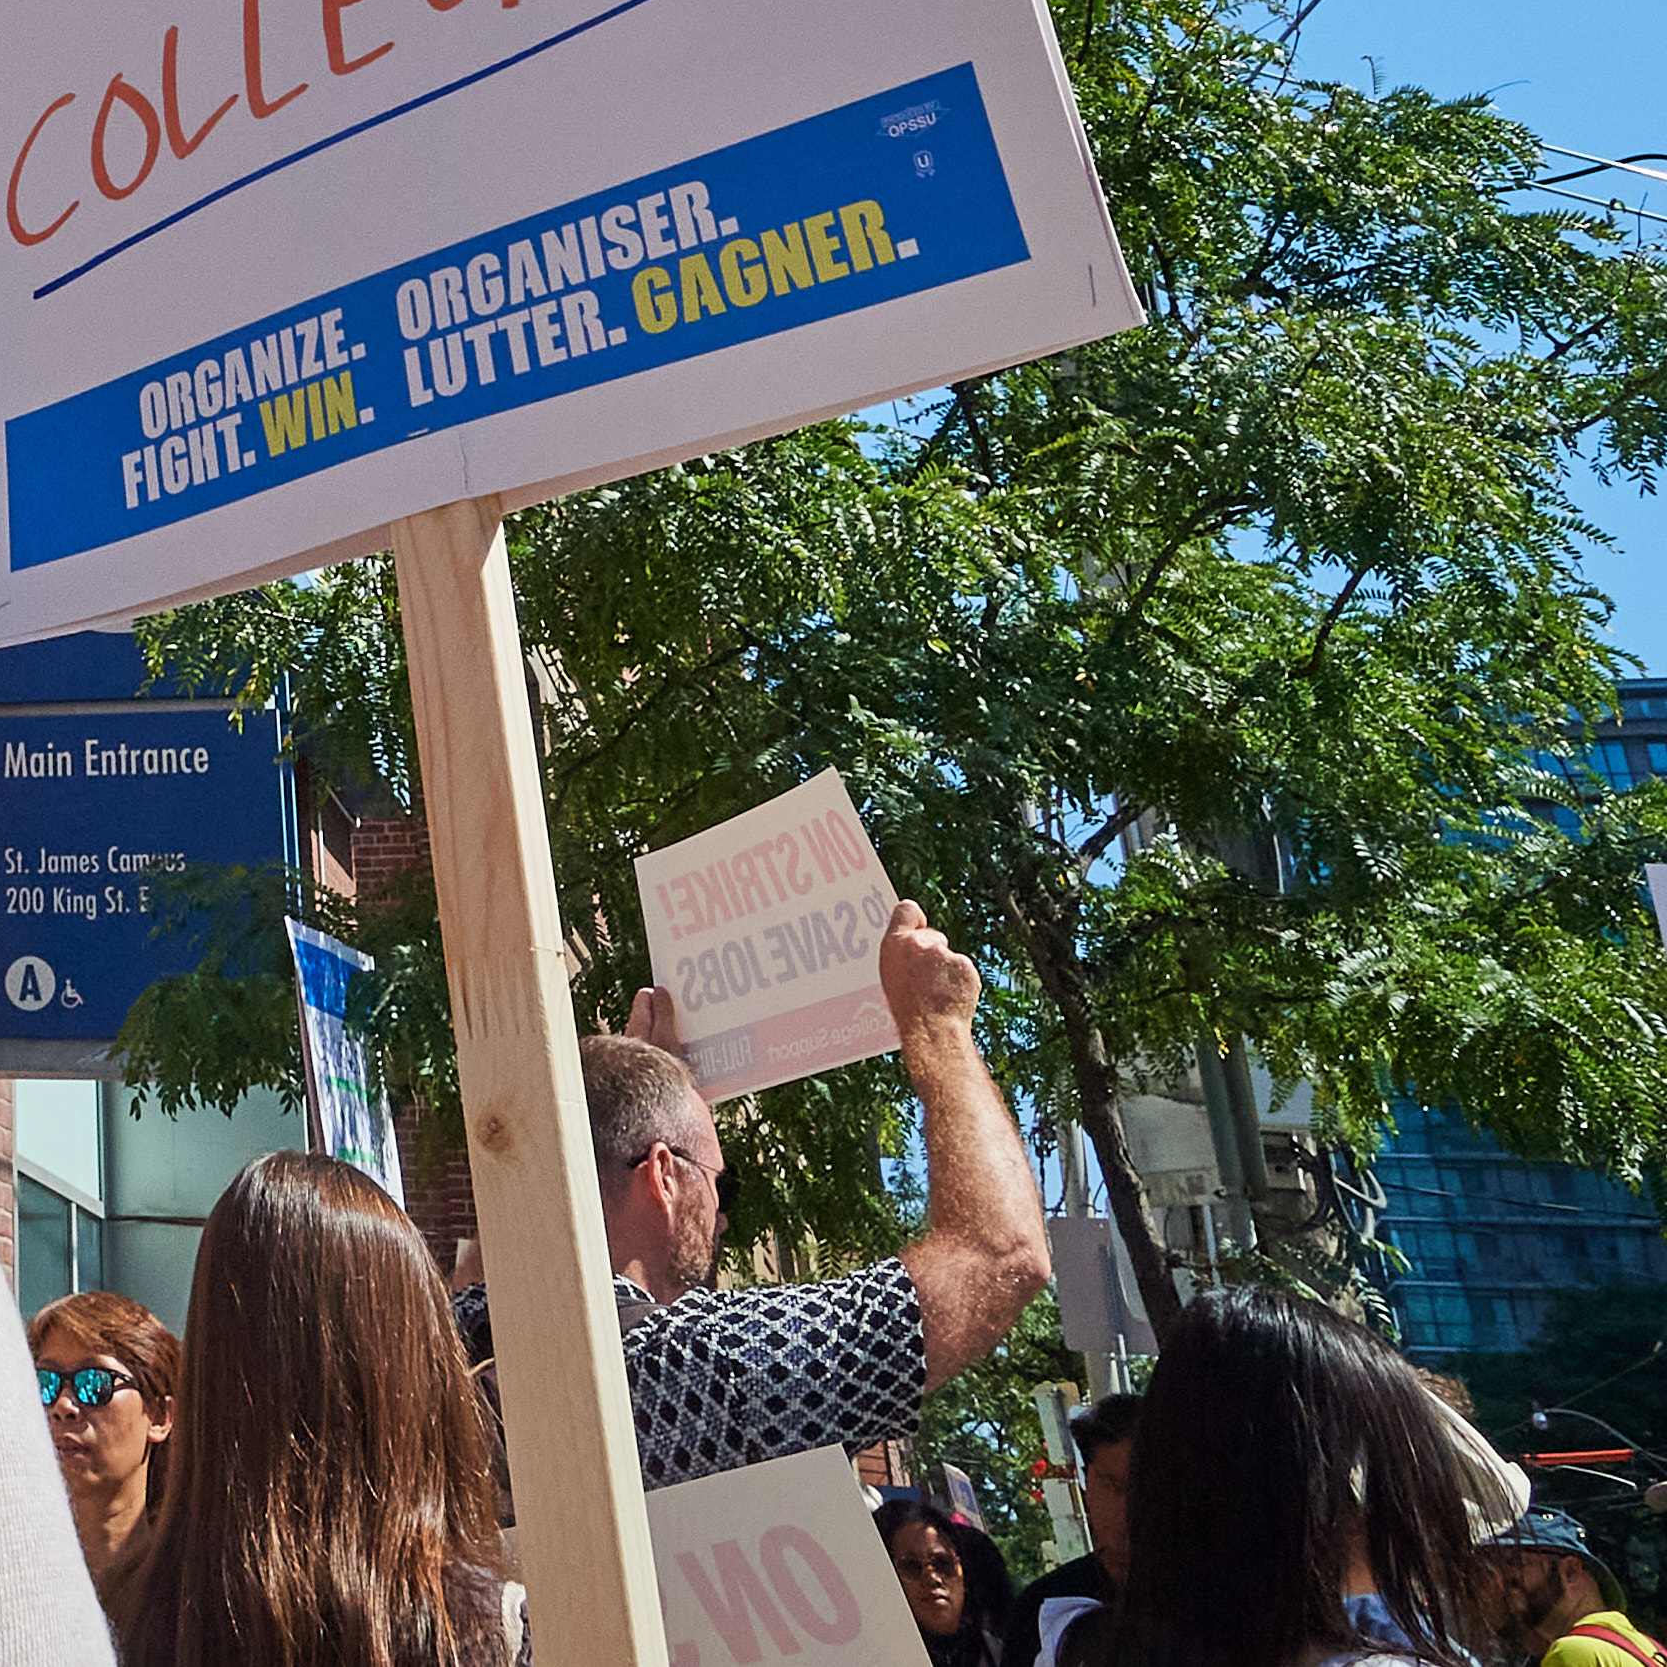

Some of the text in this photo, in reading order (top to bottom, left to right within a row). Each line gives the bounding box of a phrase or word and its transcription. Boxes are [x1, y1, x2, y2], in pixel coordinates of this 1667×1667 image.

[395, 179, 741, 342] ORGANISER.
[401, 198, 921, 409] LUTTER. GAGNER.
[139, 307, 367, 441] ORGANIZE.
[120, 370, 375, 510] FIGHT. WIN.
[4, 739, 209, 778] Main Entrance
[4, 846, 186, 874] St. James Camus
[6, 886, 44, 914] 200
[53, 887, 97, 920] King
[104, 886, 130, 914] St.
[18, 964, 42, 1001] A
